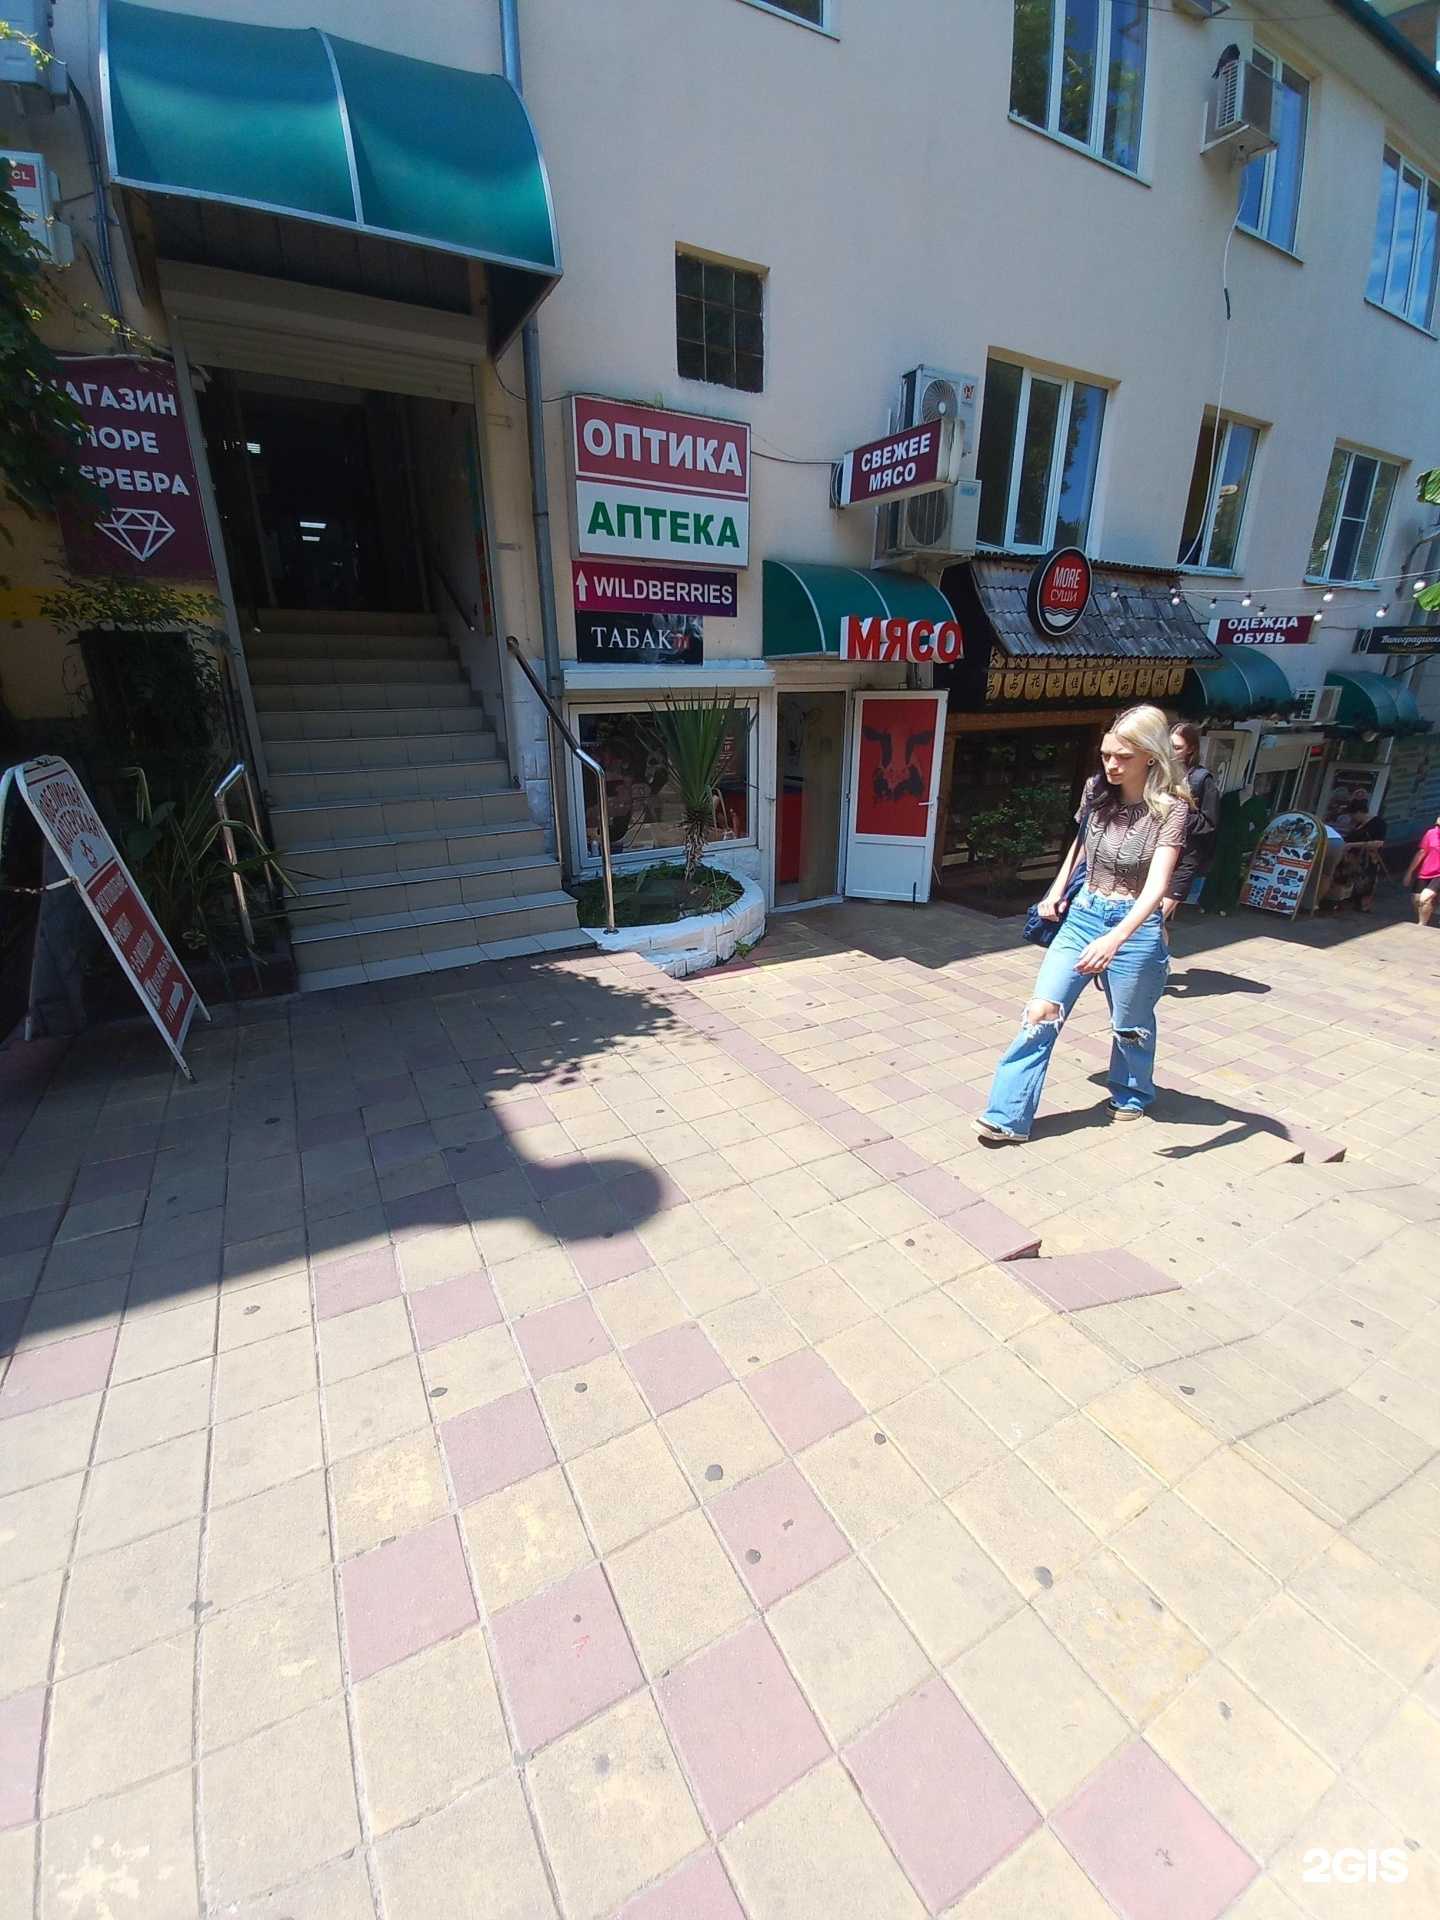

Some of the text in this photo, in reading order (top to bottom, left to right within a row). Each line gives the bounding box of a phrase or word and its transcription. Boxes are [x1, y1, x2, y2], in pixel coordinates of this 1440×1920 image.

[11, 169, 30, 180] CL
[48, 380, 178, 417] АГАЗИН
[583, 418, 743, 477] ОПТИКА
[861, 432, 931, 472] СВЕЖЕЕ
[74, 464, 190, 496] ЕРЕБРА
[868, 462, 916, 493] МЯСО
[587, 500, 740, 549] АПТЕКА
[593, 576, 733, 605] WILDBERRIES
[1053, 566, 1082, 589] MORE
[1050, 588, 1078, 603] СУШИ
[591, 626, 673, 650] ТАБАК
[1228, 616, 1299, 631] ОДЕЖДА
[1233, 632, 1286, 644] ОБУВЬ
[841, 615, 964, 664] МЯСО
